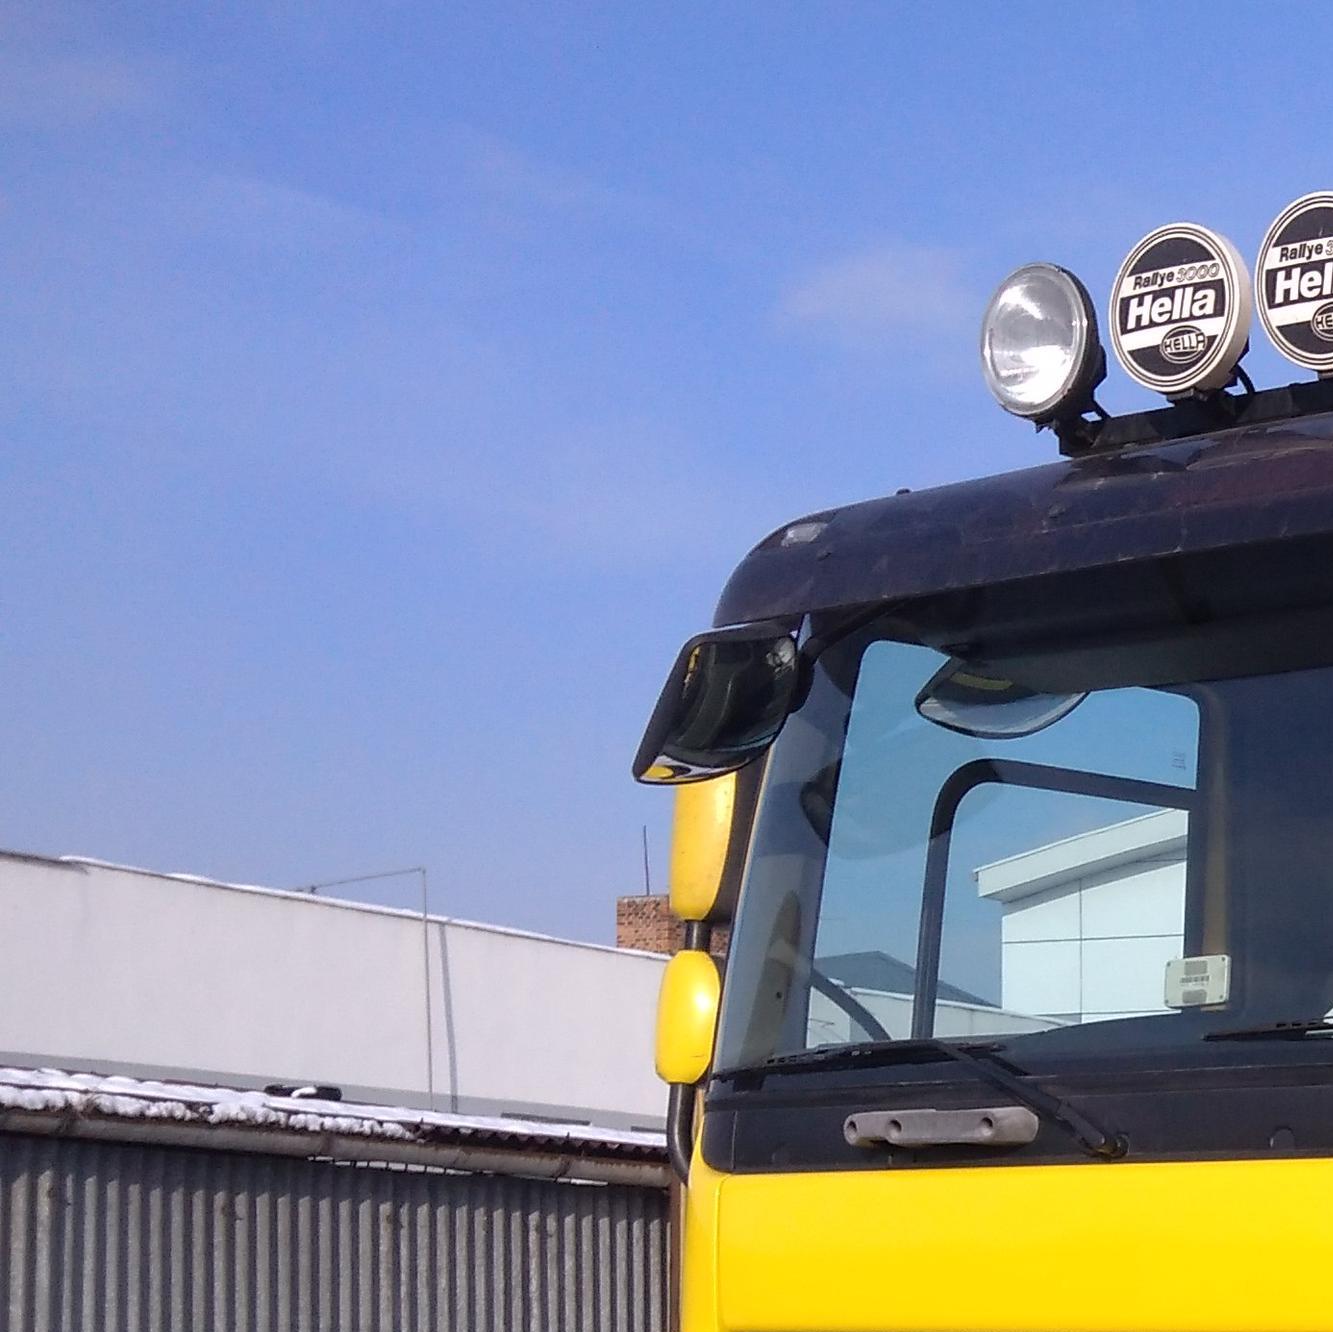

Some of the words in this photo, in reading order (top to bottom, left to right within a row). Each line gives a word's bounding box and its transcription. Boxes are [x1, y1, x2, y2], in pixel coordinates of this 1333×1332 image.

[1279, 242, 1324, 263] Rallye
[1132, 271, 1175, 290] Rallye
[1176, 262, 1220, 283] 3000
[1126, 286, 1217, 330] Hella
[1163, 333, 1206, 353] HELLA
